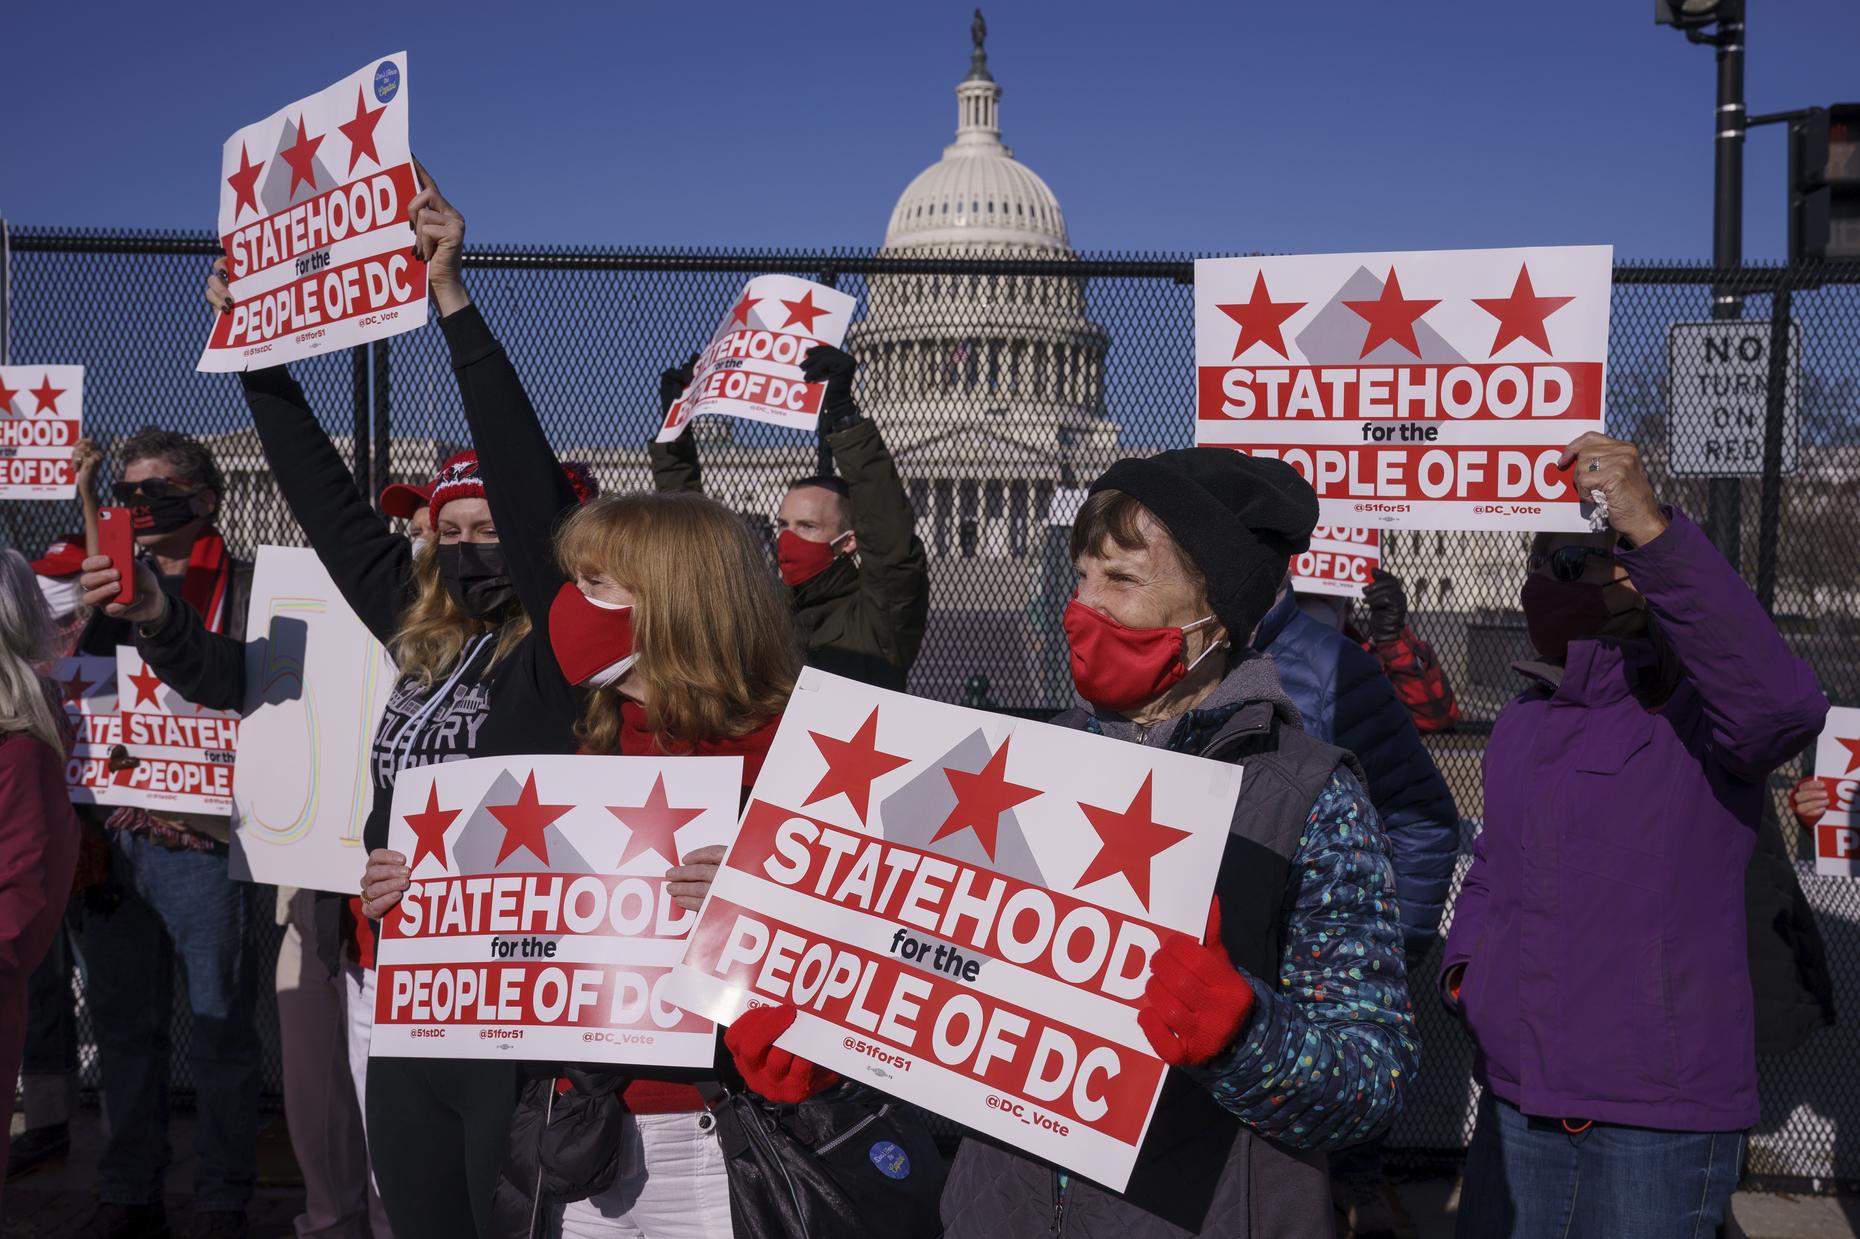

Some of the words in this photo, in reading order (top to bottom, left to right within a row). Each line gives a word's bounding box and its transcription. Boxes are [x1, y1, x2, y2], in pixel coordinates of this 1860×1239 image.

[231, 174, 398, 277] STATEHOOD
[295, 257, 309, 276] for
[310, 251, 330, 272] the
[226, 278, 321, 346] PEOPLE
[324, 265, 360, 319] OF
[364, 254, 412, 309] DC
[295, 329, 326, 344] @51for51
[359, 311, 399, 328] @DC_Vote
[724, 359, 743, 368] the
[1705, 336, 1761, 363] NO
[725, 372, 766, 400] OF
[765, 379, 808, 410] DC
[1221, 366, 1573, 419] STATEHOOD
[1700, 375, 1769, 395] TURN
[0, 420, 69, 446] HOOD
[1362, 422, 1396, 442] for
[1399, 422, 1438, 442] the
[1715, 407, 1753, 429] ON
[1706, 439, 1760, 461] RED
[11, 460, 37, 484] OF
[41, 460, 68, 484] DC
[1234, 448, 1408, 497] OPLE
[1418, 449, 1488, 498] OF
[1498, 449, 1567, 500] DC
[1354, 503, 1411, 513] @51for51
[1473, 505, 1541, 516] @DC_Vote
[1296, 551, 1331, 577] OF
[1334, 555, 1367, 582] DC
[130, 713, 238, 750] STATEH
[205, 750, 221, 762] for
[128, 760, 231, 795] PEOPLE
[398, 876, 697, 937] STATEHOOD
[764, 817, 1160, 1001] STATEHOOD
[491, 936, 518, 957] for
[521, 936, 557, 957] the
[889, 928, 932, 963] for
[931, 943, 981, 983] the
[390, 968, 526, 1022] PEOPLE
[532, 967, 604, 1023] OF
[610, 970, 684, 1029] DC
[715, 914, 935, 1048] PEOPLE
[931, 993, 1032, 1077] OF
[1023, 1025, 1122, 1122] DC
[410, 1028, 446, 1039] @51stDC
[479, 1028, 524, 1040] @51for51
[582, 1032, 654, 1046] @DC_Vote
[843, 1036, 912, 1072] @51for51
[985, 1094, 1070, 1137] @DC_Vote
